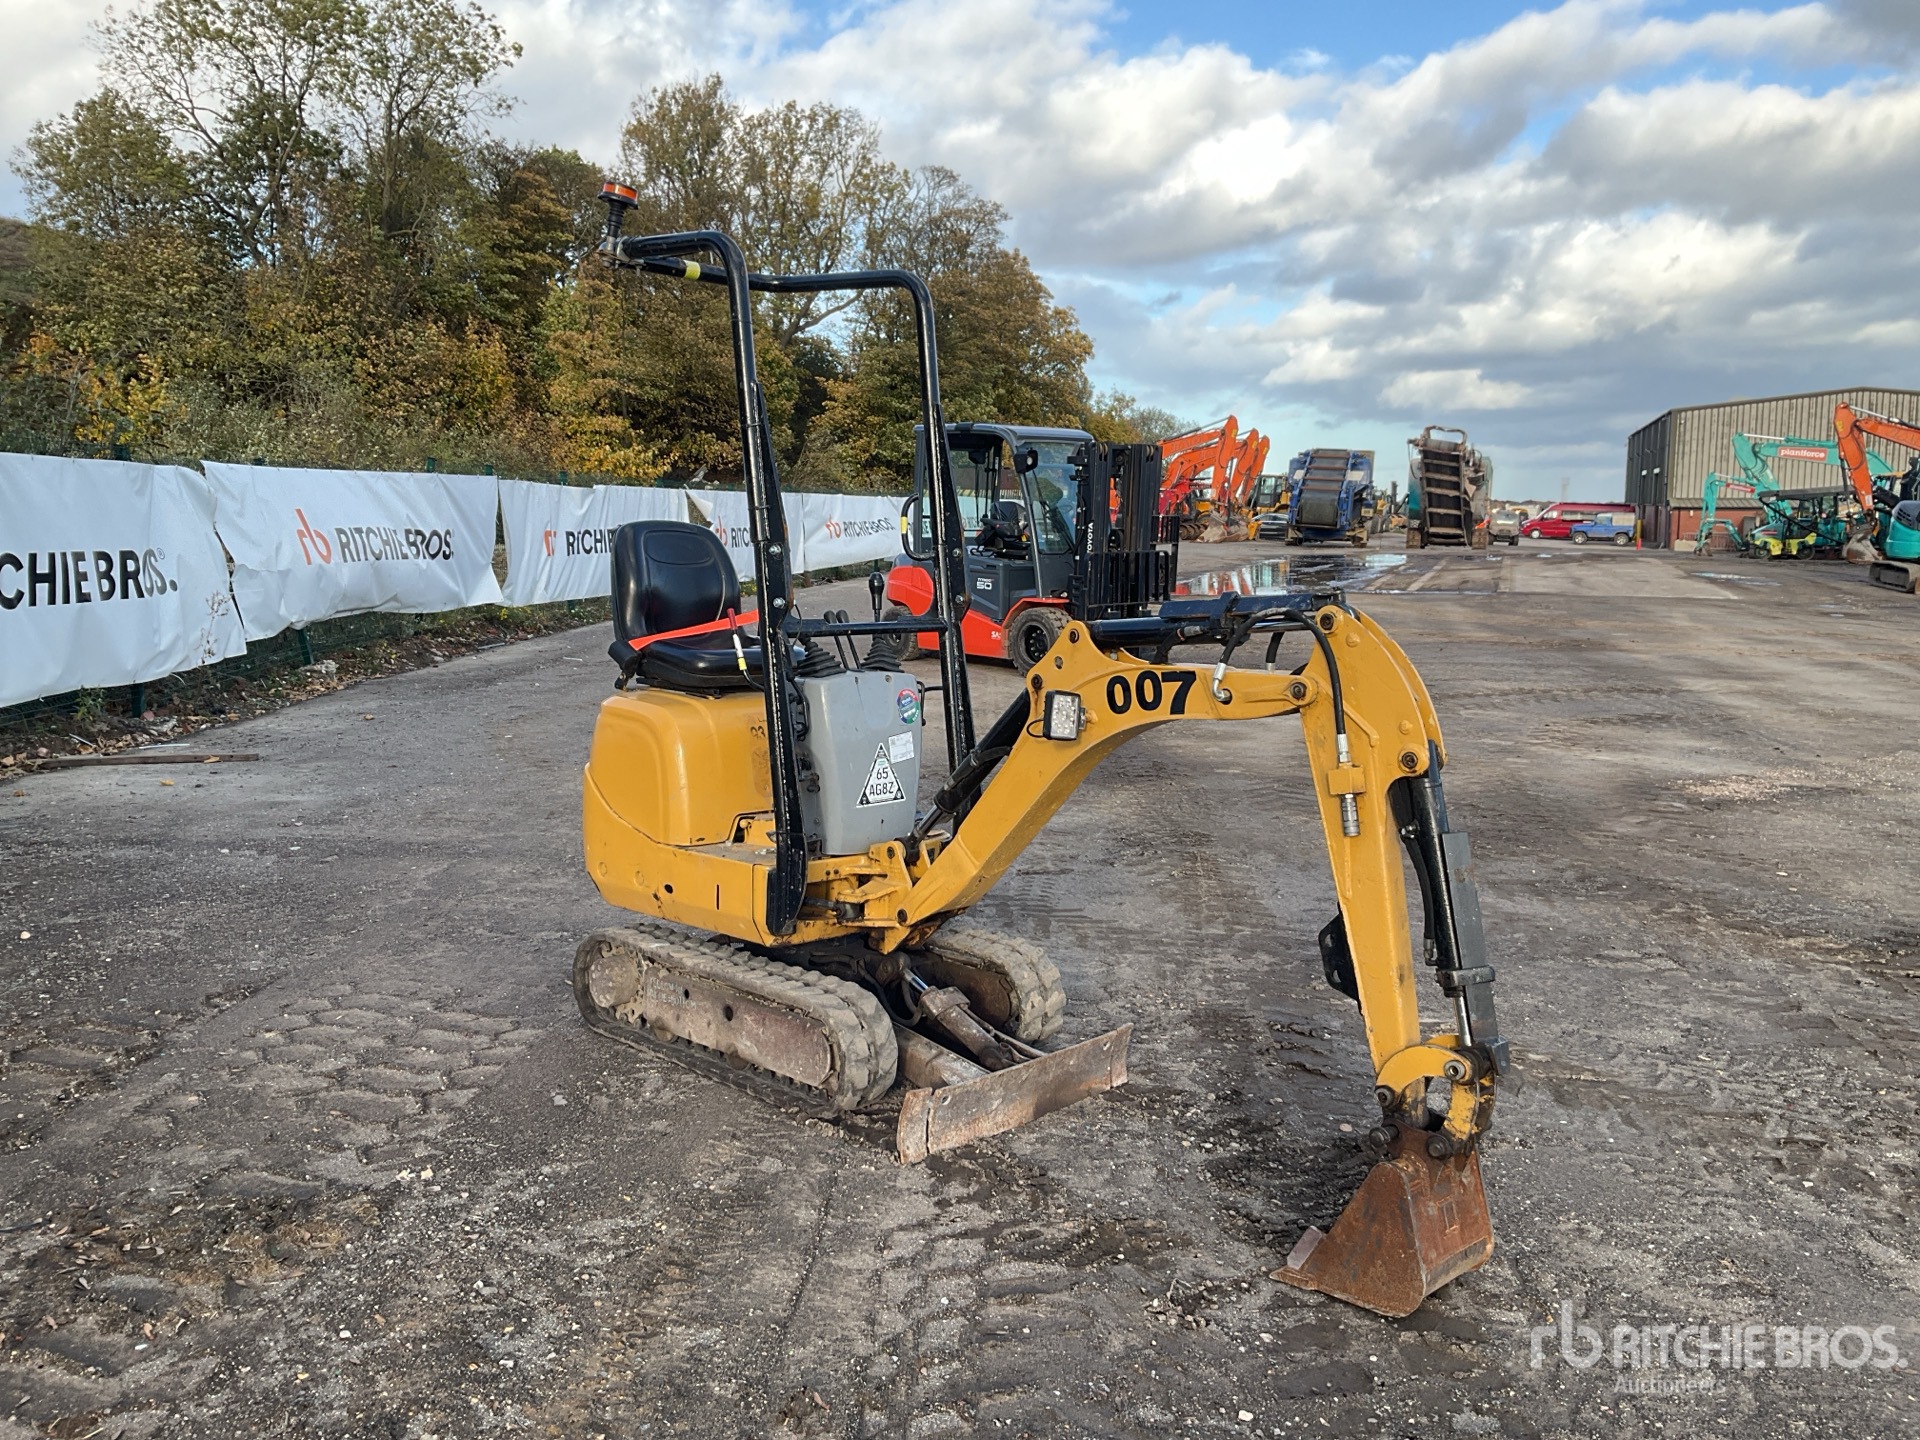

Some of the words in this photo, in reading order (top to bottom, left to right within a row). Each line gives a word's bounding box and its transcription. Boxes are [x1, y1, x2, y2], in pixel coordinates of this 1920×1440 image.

[1780, 448, 1825, 459] plantforce
[0, 551, 92, 610] CHIE
[976, 581, 992, 590] 50
[1106, 670, 1197, 715] 007
[876, 767, 889, 780] 65
